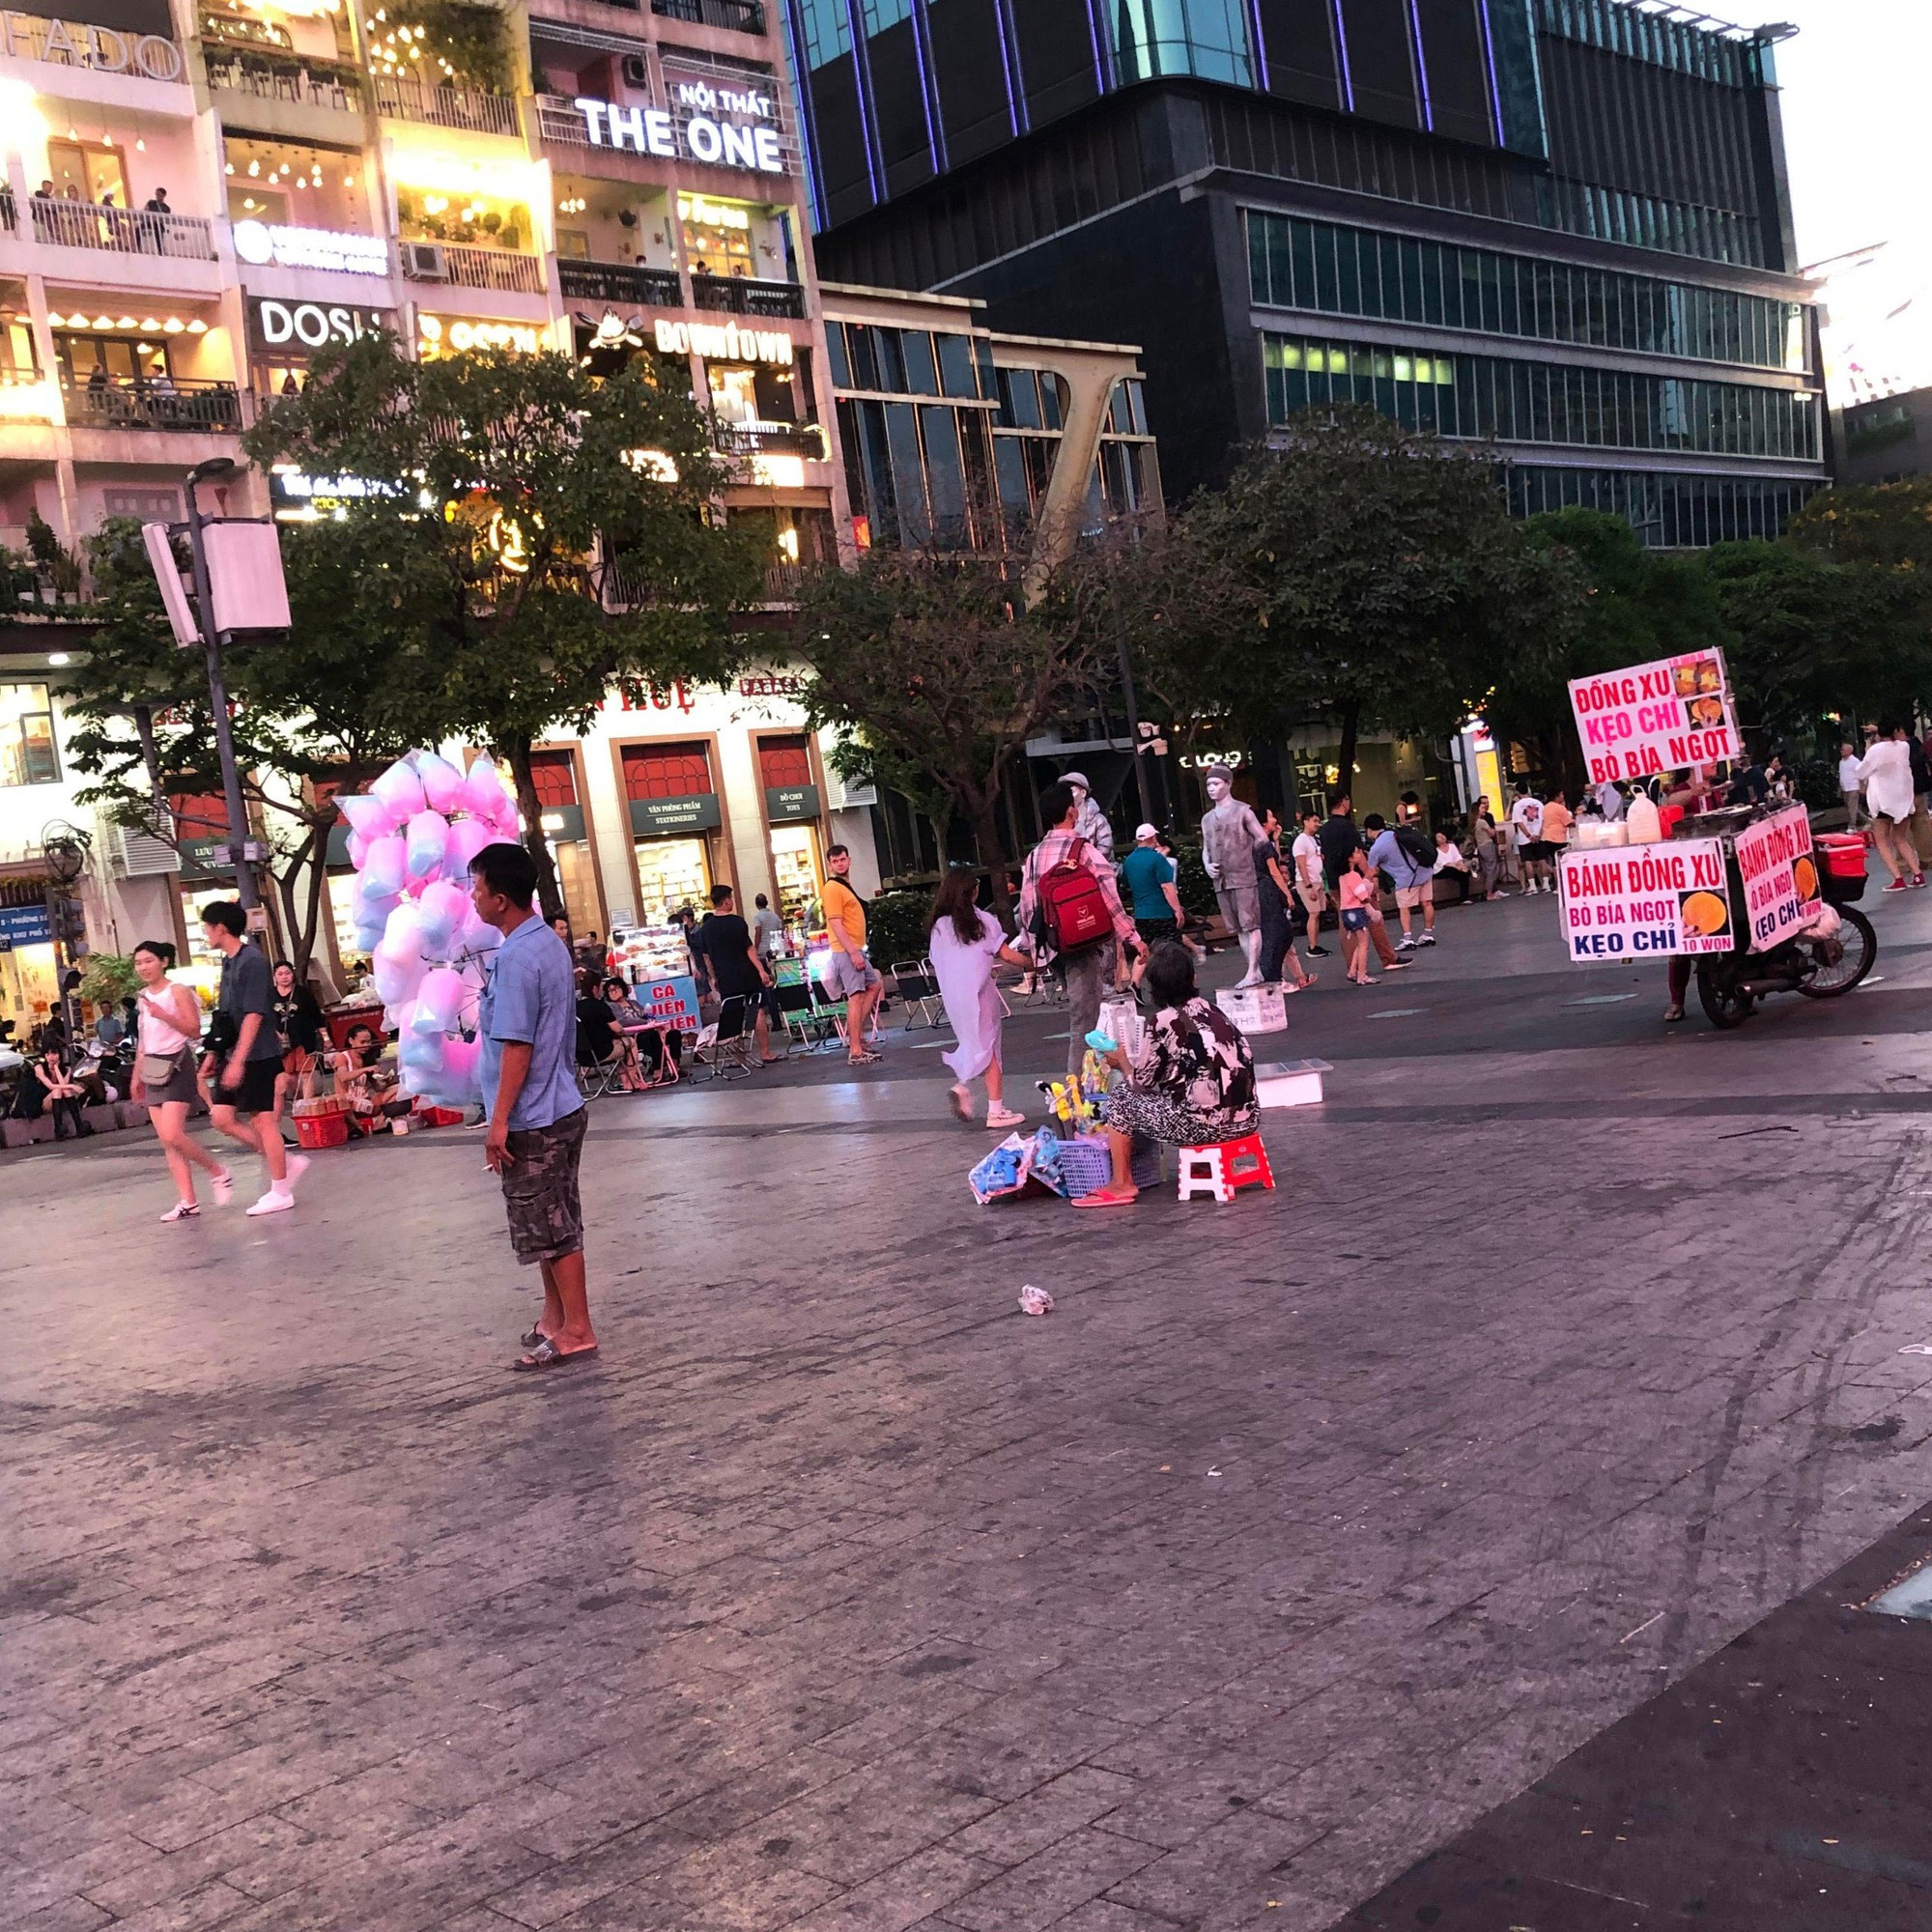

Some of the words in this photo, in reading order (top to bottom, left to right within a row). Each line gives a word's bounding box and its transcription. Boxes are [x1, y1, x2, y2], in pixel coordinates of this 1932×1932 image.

[679, 80, 717, 111] NỘI
[575, 98, 675, 156] THE
[687, 117, 782, 173] ONE
[1576, 679, 1636, 714] ĐỒNG
[1638, 669, 1670, 701] XU
[1585, 712, 1633, 747] KẸO
[1637, 695, 1681, 734] CHỈ
[1590, 751, 1621, 784] BÒ
[1625, 744, 1663, 778] BÍA
[1668, 728, 1730, 764] NGỌT
[1794, 818, 1809, 855] XU
[1567, 859, 1623, 898] BÁNH
[1628, 848, 1686, 893] ĐỒNG
[1690, 853, 1720, 887] XU
[1570, 902, 1591, 927] BÒ
[1597, 900, 1626, 924] BÍA
[1631, 899, 1675, 925] NGỌT
[1575, 932, 1624, 957] KẸO
[1633, 923, 1677, 952] CHỈ
[1683, 940, 1697, 952] 10
[1700, 937, 1731, 952] WON
